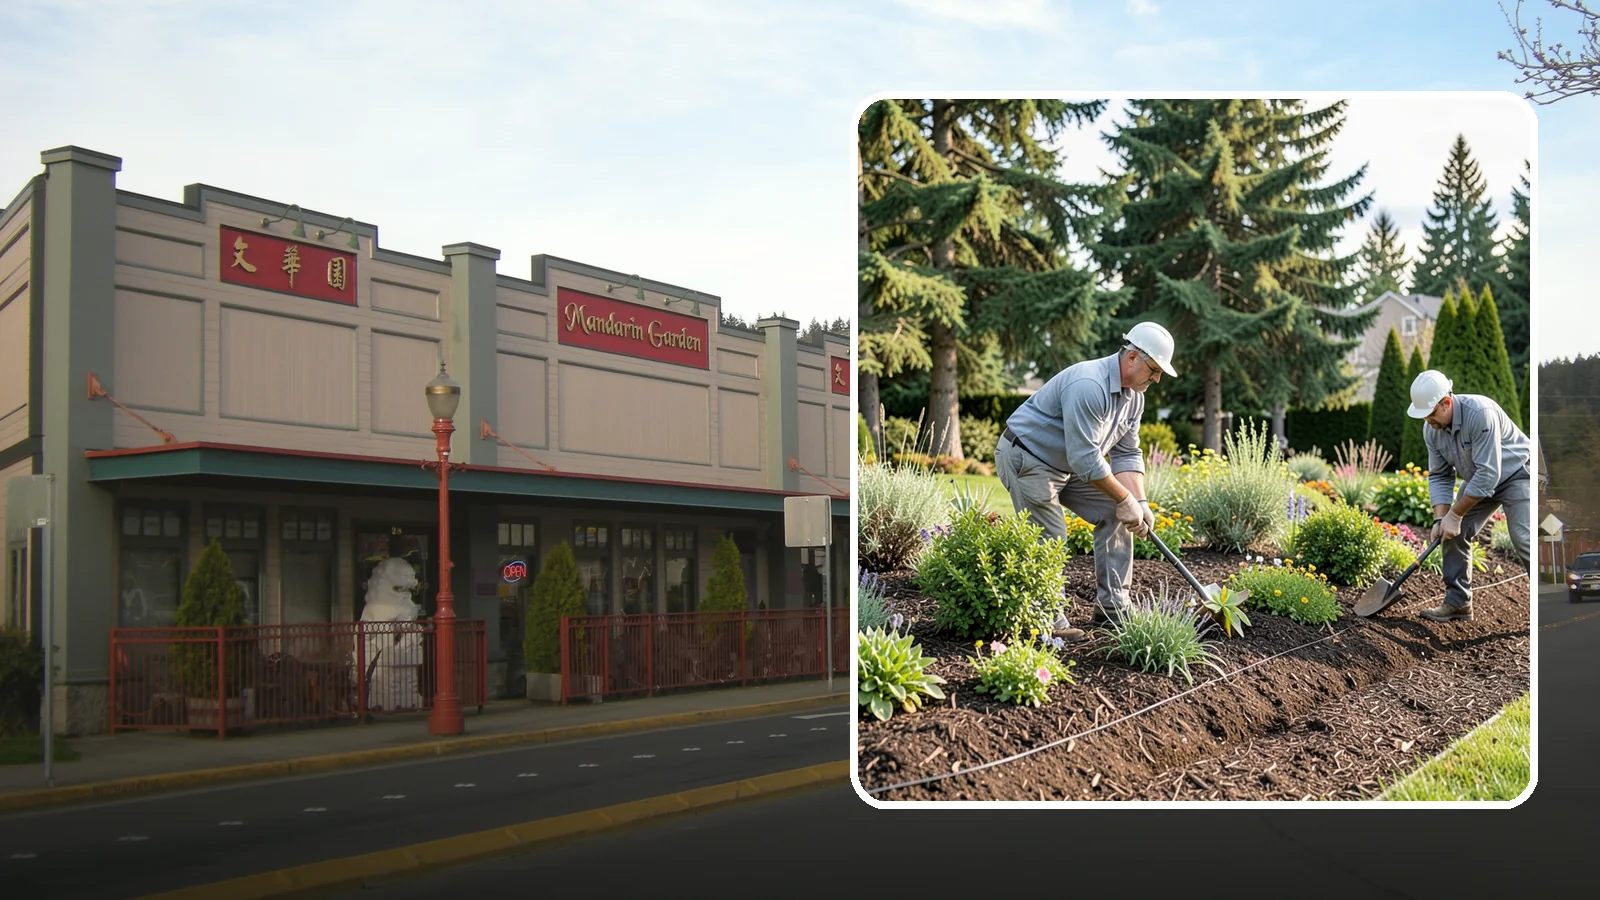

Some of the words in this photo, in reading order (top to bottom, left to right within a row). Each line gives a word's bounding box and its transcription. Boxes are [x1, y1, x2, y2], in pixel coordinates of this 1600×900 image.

[231, 236, 346, 291] 文華園
[564, 302, 644, 341] Mandarin
[648, 320, 701, 352] Garden
[503, 565, 527, 578] OPEN
